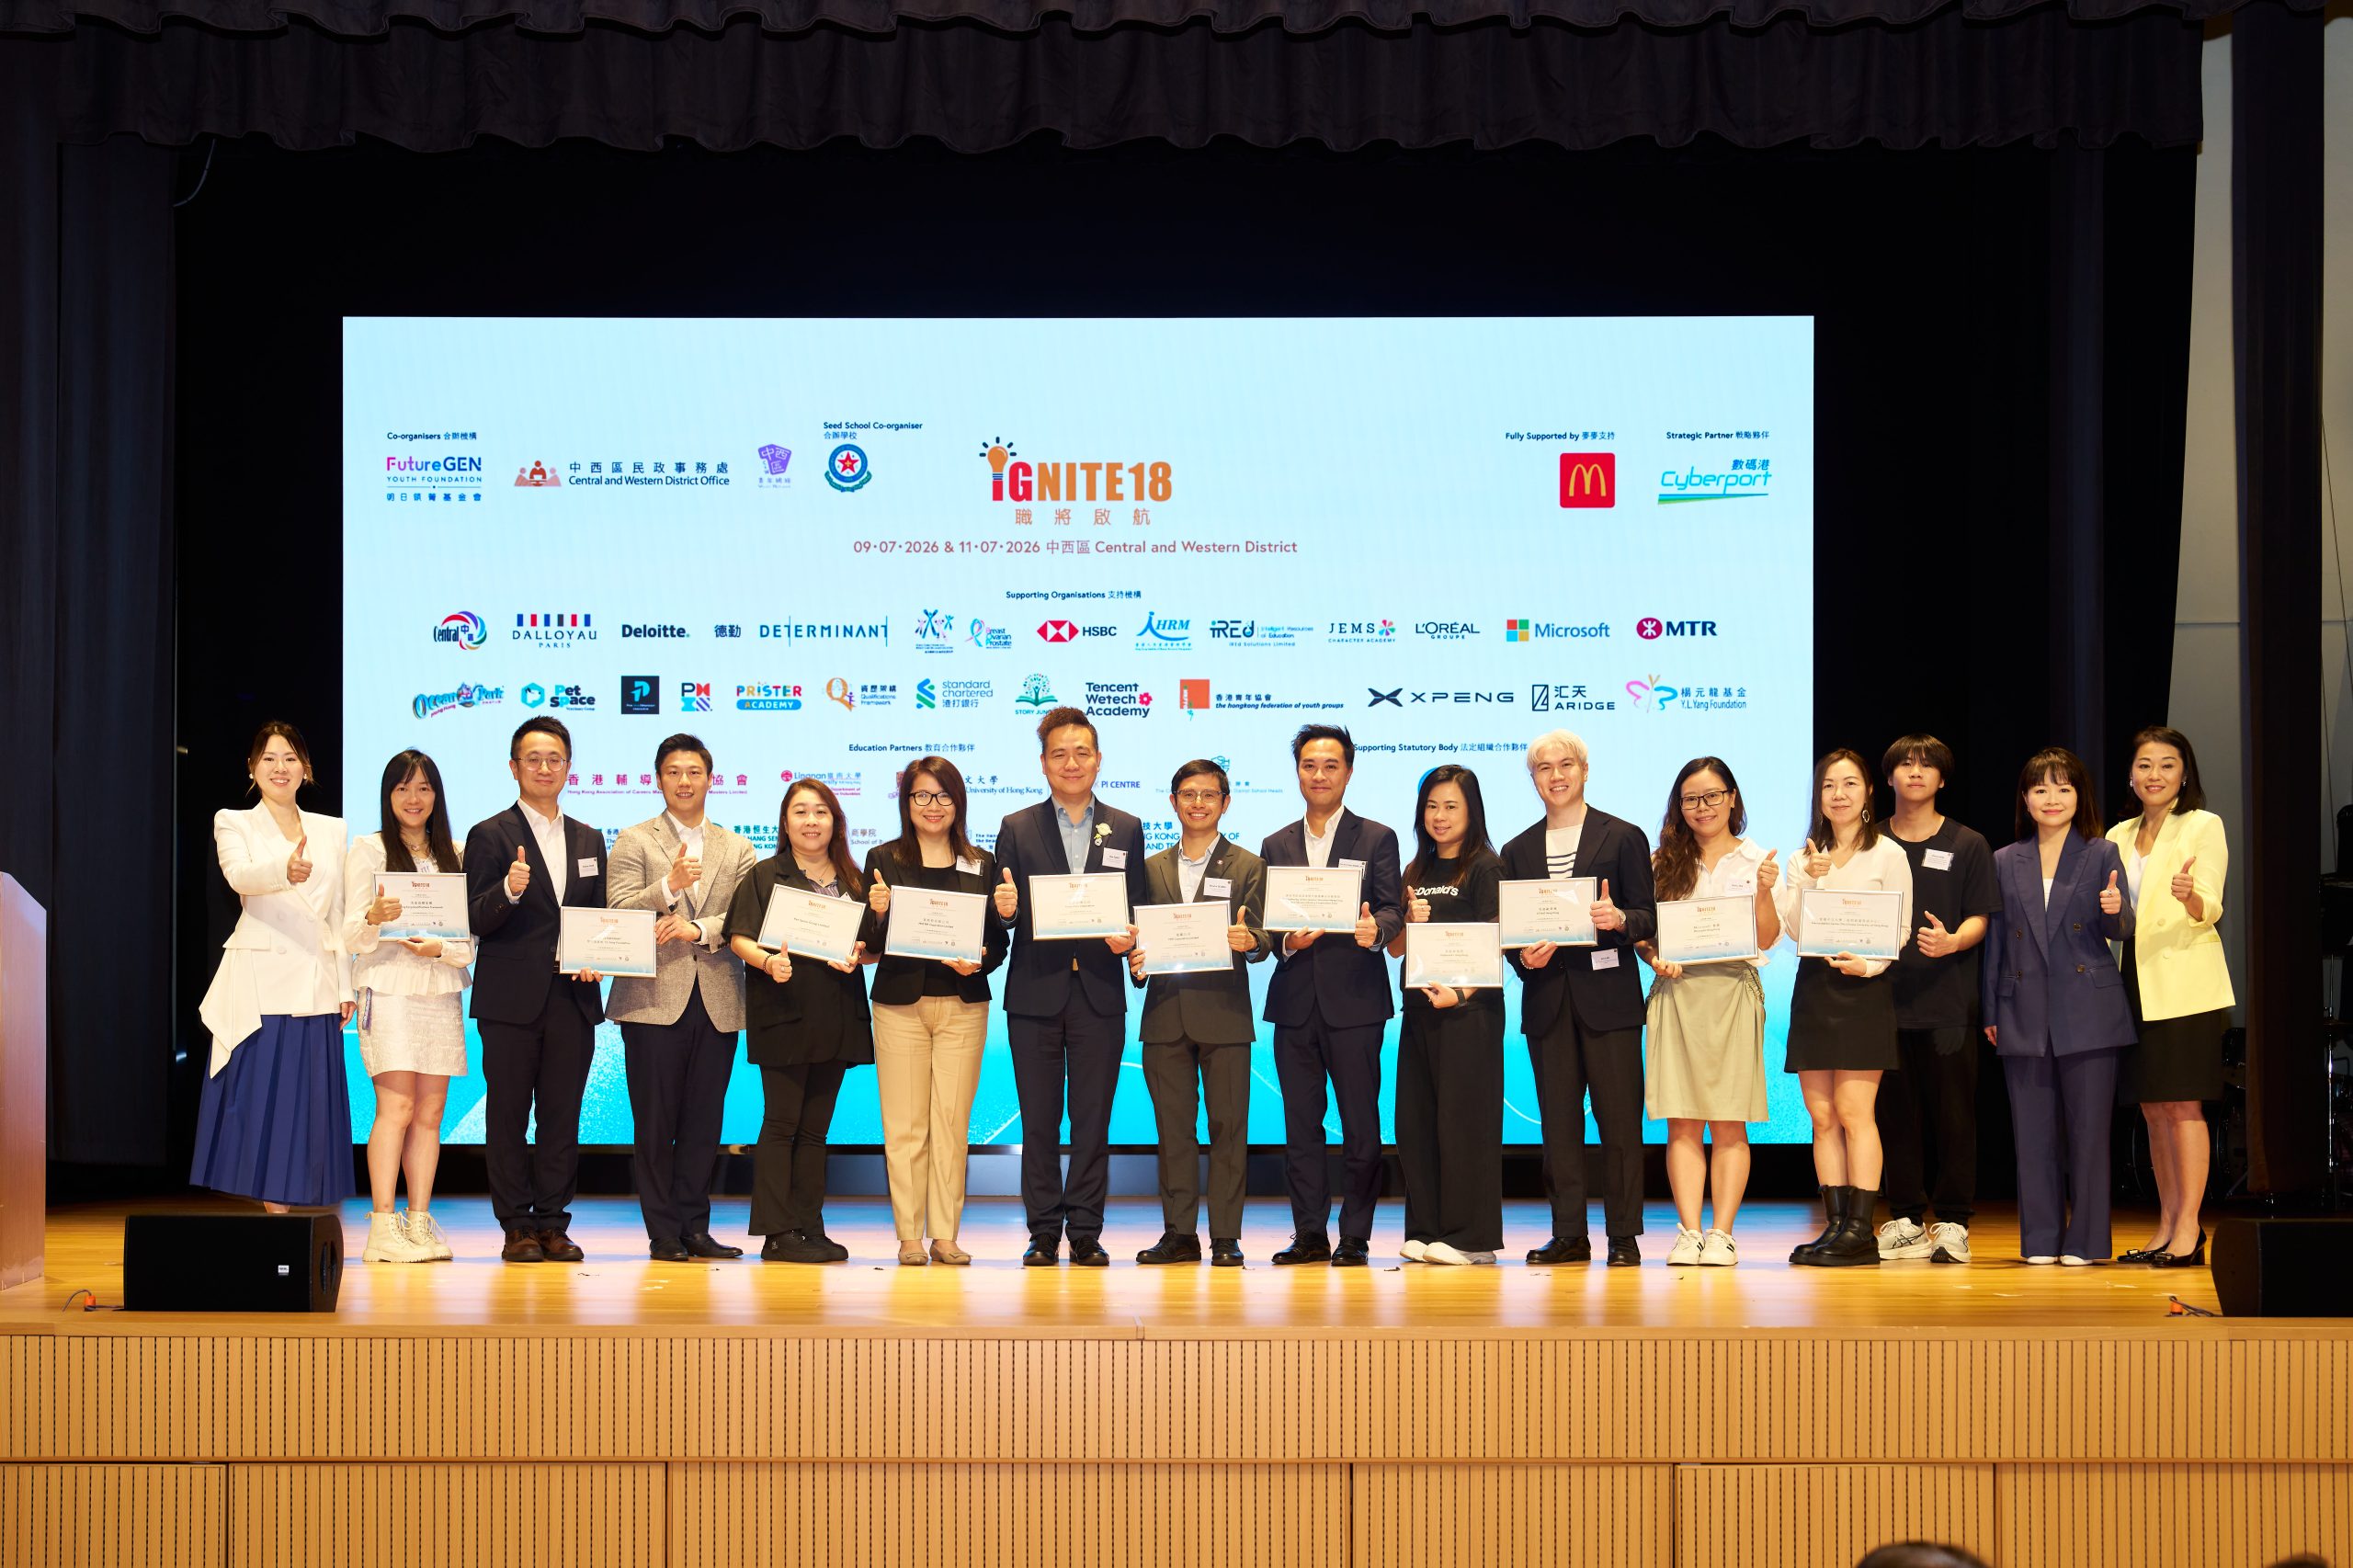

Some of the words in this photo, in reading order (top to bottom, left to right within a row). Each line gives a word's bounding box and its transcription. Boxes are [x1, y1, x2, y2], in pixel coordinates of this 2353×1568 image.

[873, 422, 923, 431] Co-organiser
[387, 432, 440, 441] Co-organisers
[1506, 432, 1524, 441] Fully
[1527, 432, 1566, 441] Supported
[1570, 432, 1579, 441] by
[1666, 432, 1701, 441] Strategic
[387, 456, 481, 472] FutureGEN
[570, 461, 728, 473] 中西區民政事務處
[1731, 460, 1770, 471] 數碼港
[569, 476, 602, 484] Central
[605, 476, 622, 484] and
[624, 476, 663, 484] Western
[665, 476, 699, 485] District
[700, 475, 730, 485] Office
[1661, 466, 1772, 494] Cyberport
[1016, 508, 1150, 525] 職將啟航
[944, 541, 954, 552] &
[1047, 540, 1090, 554] 中西區
[1096, 540, 1145, 552] Central
[1152, 540, 1176, 552] and
[1181, 541, 1239, 552] Western
[1245, 540, 1297, 552] District
[1006, 591, 1049, 600] Supporting
[1051, 591, 1105, 600] Organisations
[622, 624, 689, 638] Deloitte.
[714, 625, 741, 638] 德勤
[1083, 627, 1117, 636] HSBC
[1329, 623, 1374, 633] JEMS
[1535, 622, 1609, 637] Microsoft
[1666, 621, 1717, 636] MTR
[434, 625, 459, 642] Central
[513, 631, 597, 640] DALLOYAU
[942, 680, 990, 689] standard
[1086, 682, 1139, 692] Tencent
[555, 685, 581, 696] Pet
[942, 688, 993, 698] chartered
[1554, 686, 1586, 698] 汇天
[1681, 687, 1746, 698] 楊元龍基金
[550, 696, 596, 708] space
[1086, 694, 1136, 704] Wetech
[1411, 692, 1514, 702] XPENG
[943, 699, 978, 708] 渣打銀行
[1710, 699, 1746, 709] Foundation
[1086, 706, 1150, 718] Academy
[1354, 743, 1395, 753] Supporting
[1399, 744, 1436, 753] Statutory
[1439, 744, 1458, 753] Body
[1006, 787, 1024, 795] Hong
[1026, 787, 1042, 795] Kong
[1415, 885, 1459, 896] Donald's
